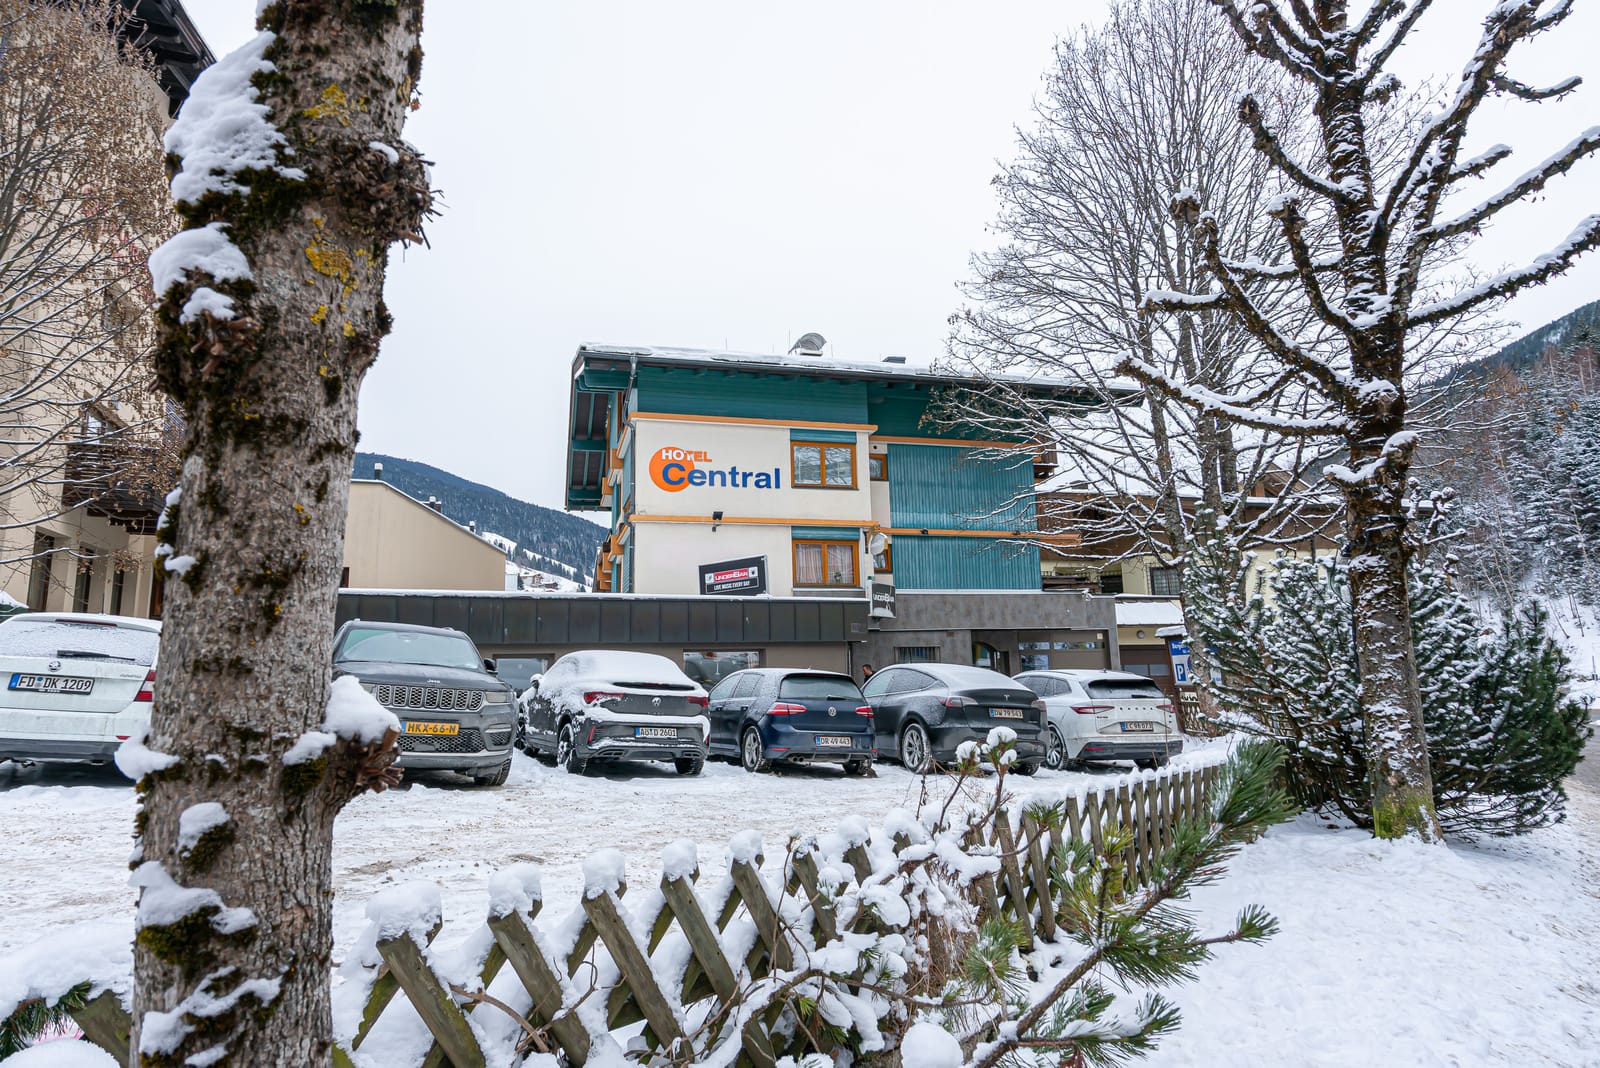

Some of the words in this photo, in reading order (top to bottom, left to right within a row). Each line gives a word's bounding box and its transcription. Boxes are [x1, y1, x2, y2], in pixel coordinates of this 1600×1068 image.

[661, 449, 712, 462] HOTEL
[662, 463, 780, 489] Central
[1177, 665, 1184, 680] P
[18, 676, 36, 688] FD
[42, 678, 59, 689] DK
[61, 679, 92, 691] 1209
[407, 723, 457, 733] HKX-66-N
